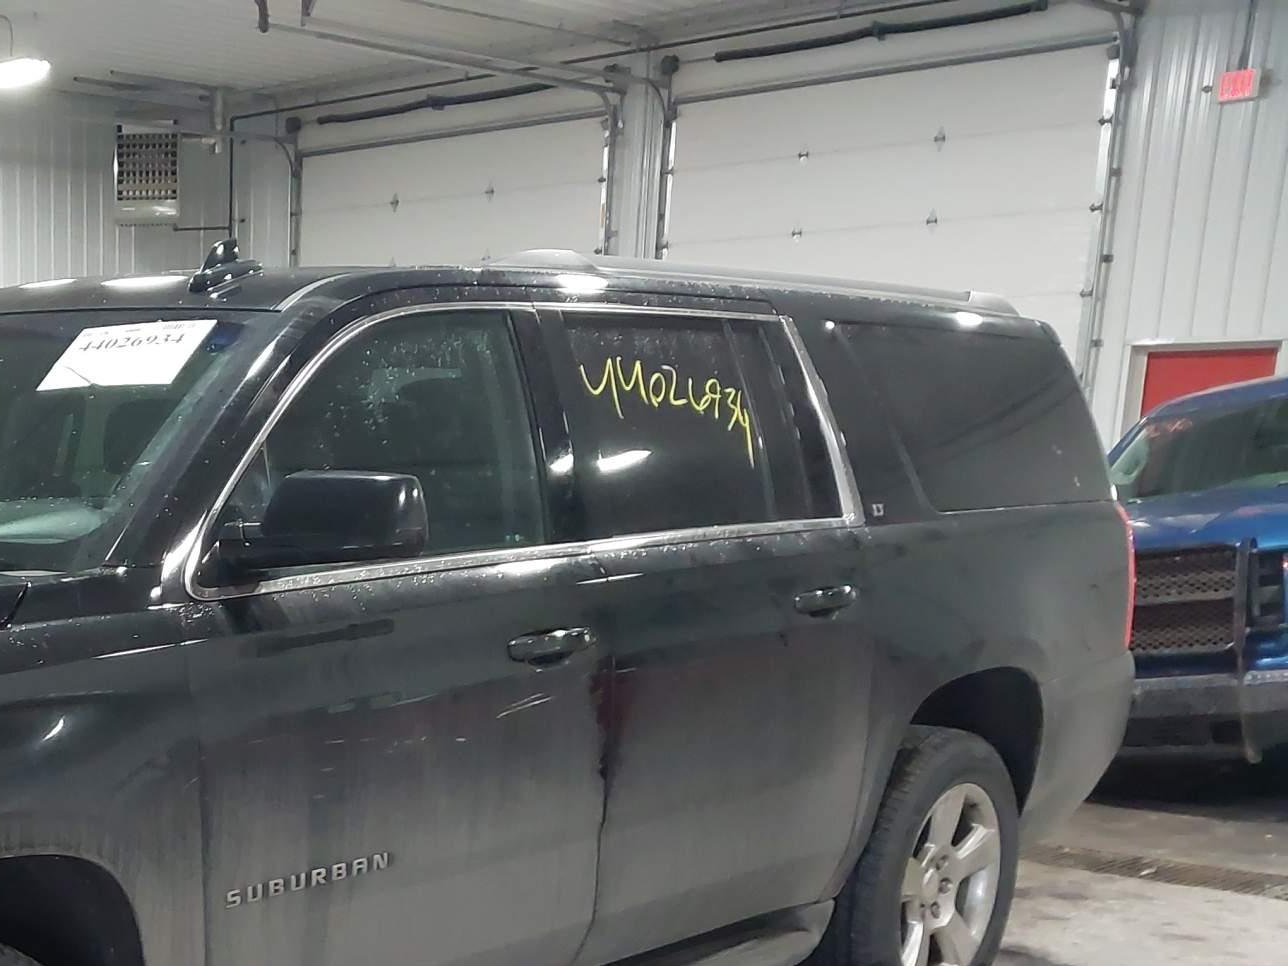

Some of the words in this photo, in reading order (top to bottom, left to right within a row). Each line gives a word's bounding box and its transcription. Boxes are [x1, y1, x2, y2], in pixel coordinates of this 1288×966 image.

[78, 333, 185, 352] 44026934
[579, 356, 755, 469] 44026934
[225, 852, 390, 909] SUBURBAN
